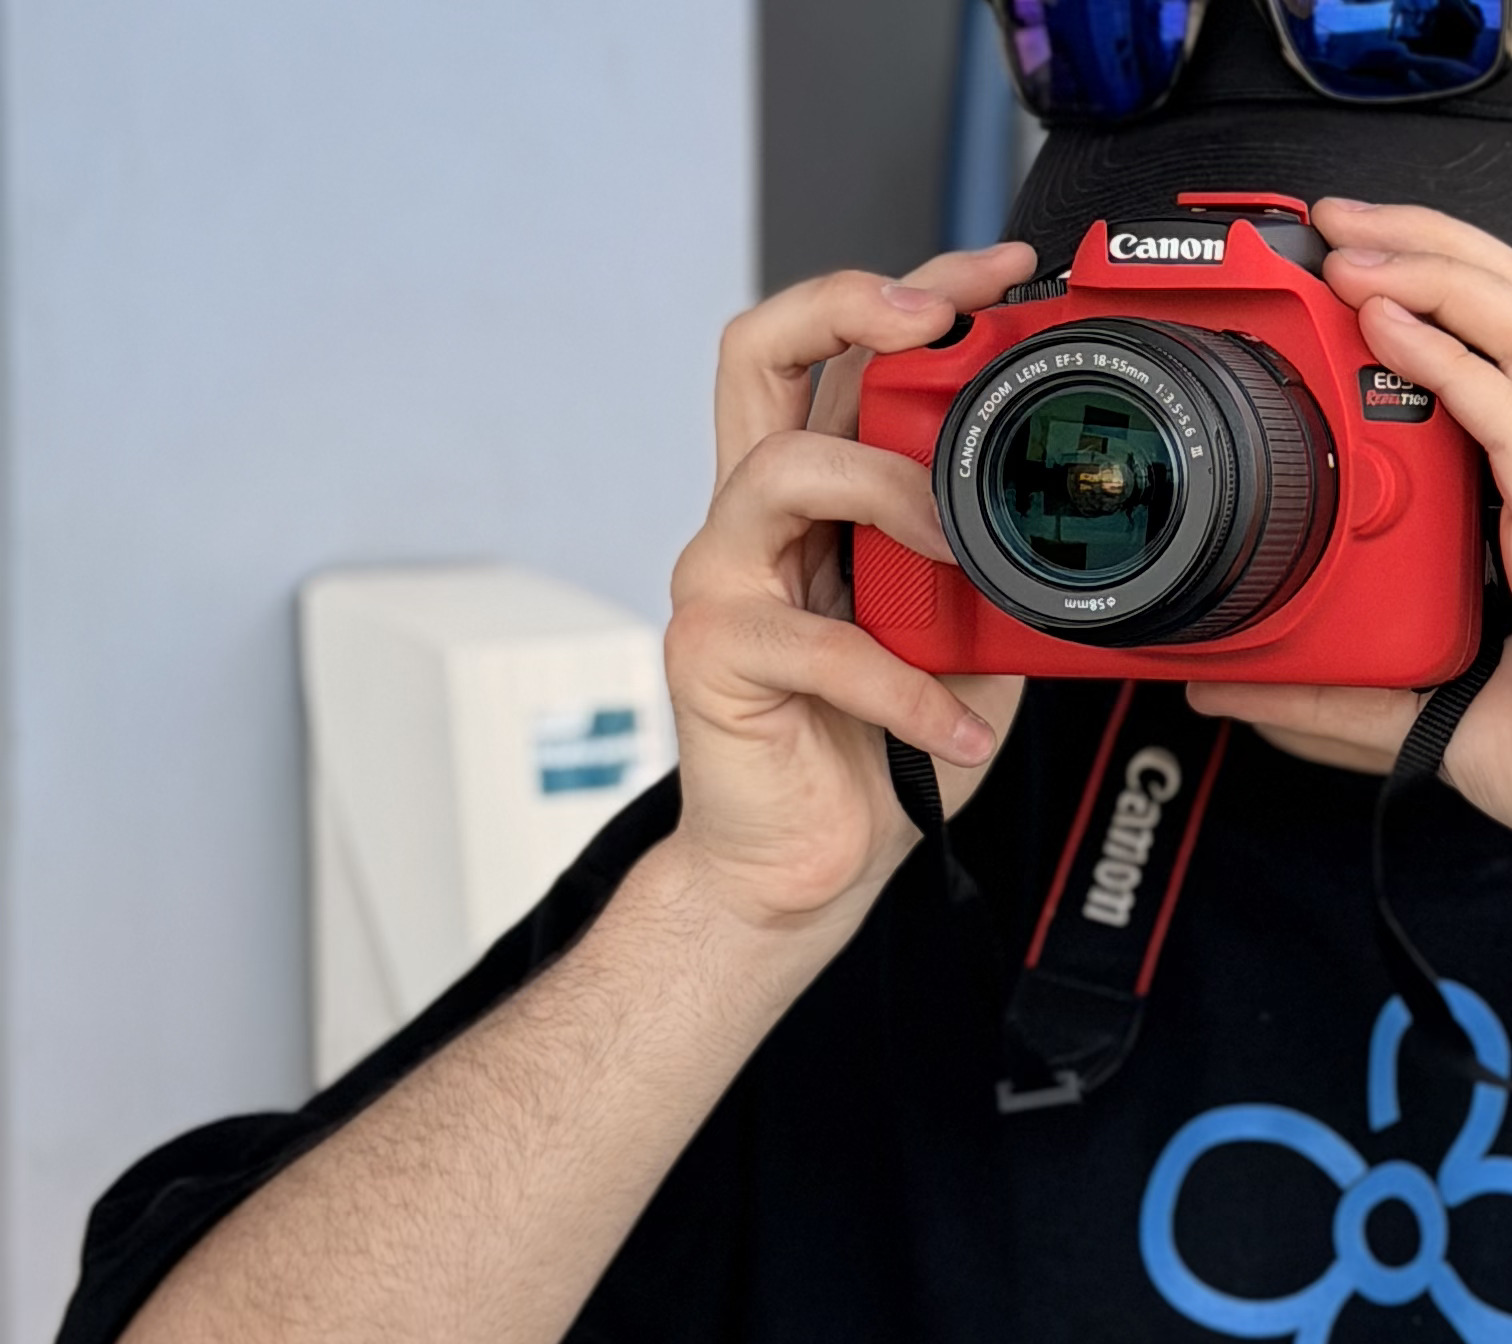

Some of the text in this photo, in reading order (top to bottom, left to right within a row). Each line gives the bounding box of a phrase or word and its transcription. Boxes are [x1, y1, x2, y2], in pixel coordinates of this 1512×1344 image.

[1109, 233, 1225, 261] Canon
[959, 425, 982, 478] CANON
[977, 381, 1013, 421] ZOOM
[1015, 359, 1048, 383] LENS
[1055, 353, 1083, 368] EF-S
[1093, 354, 1150, 385] 18-55mm
[1155, 383, 1197, 438] 1:3.5-5.6
[1083, 747, 1181, 927] Canon
